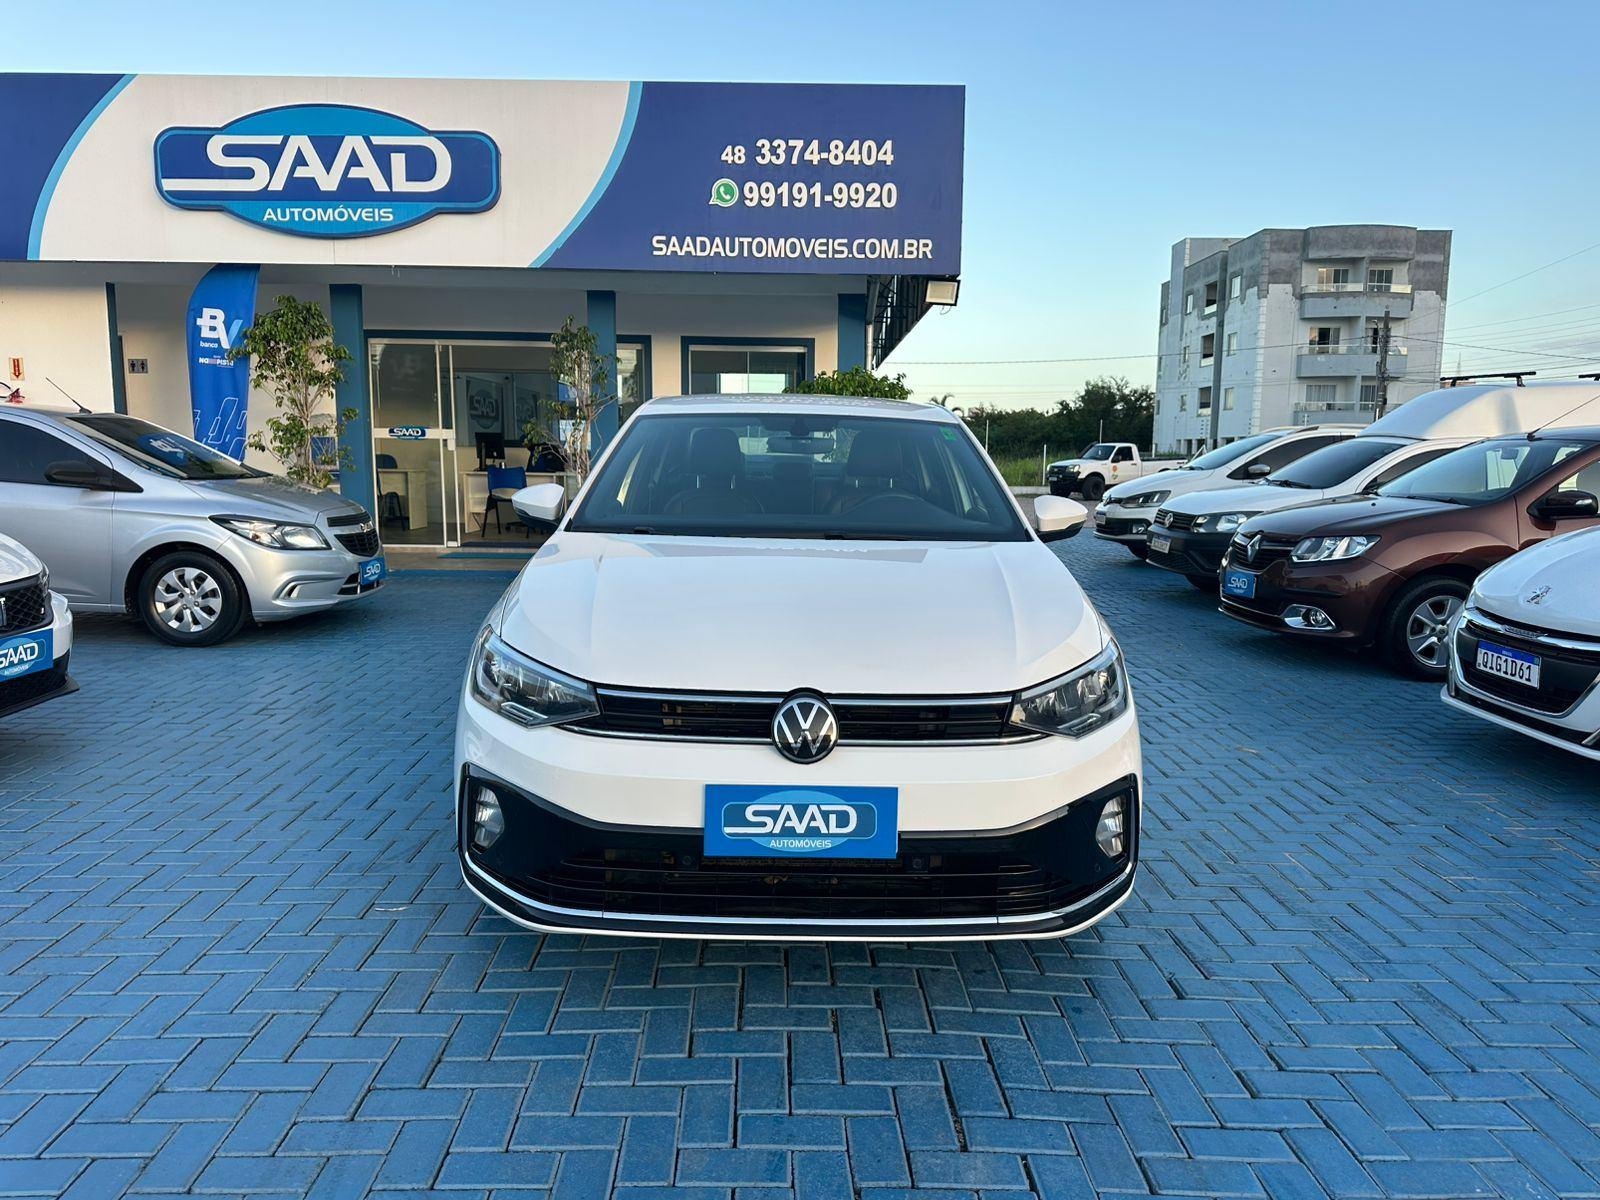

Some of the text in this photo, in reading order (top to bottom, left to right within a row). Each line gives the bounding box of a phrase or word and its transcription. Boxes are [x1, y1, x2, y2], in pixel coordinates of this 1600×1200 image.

[161, 135, 452, 192] SAAD
[721, 139, 894, 165] 48 3374-8404
[743, 181, 898, 208] 99191-9920
[263, 203, 394, 222] AUTOMÓVEIS
[651, 235, 933, 259] SAADAUTOMOVEIS.COM.BR
[196, 307, 243, 349] BV
[389, 428, 422, 436] SAAD
[1482, 651, 1532, 682] QIG1D61
[724, 804, 858, 834] SAAD
[769, 838, 832, 848] AUTOMÓVEIS
